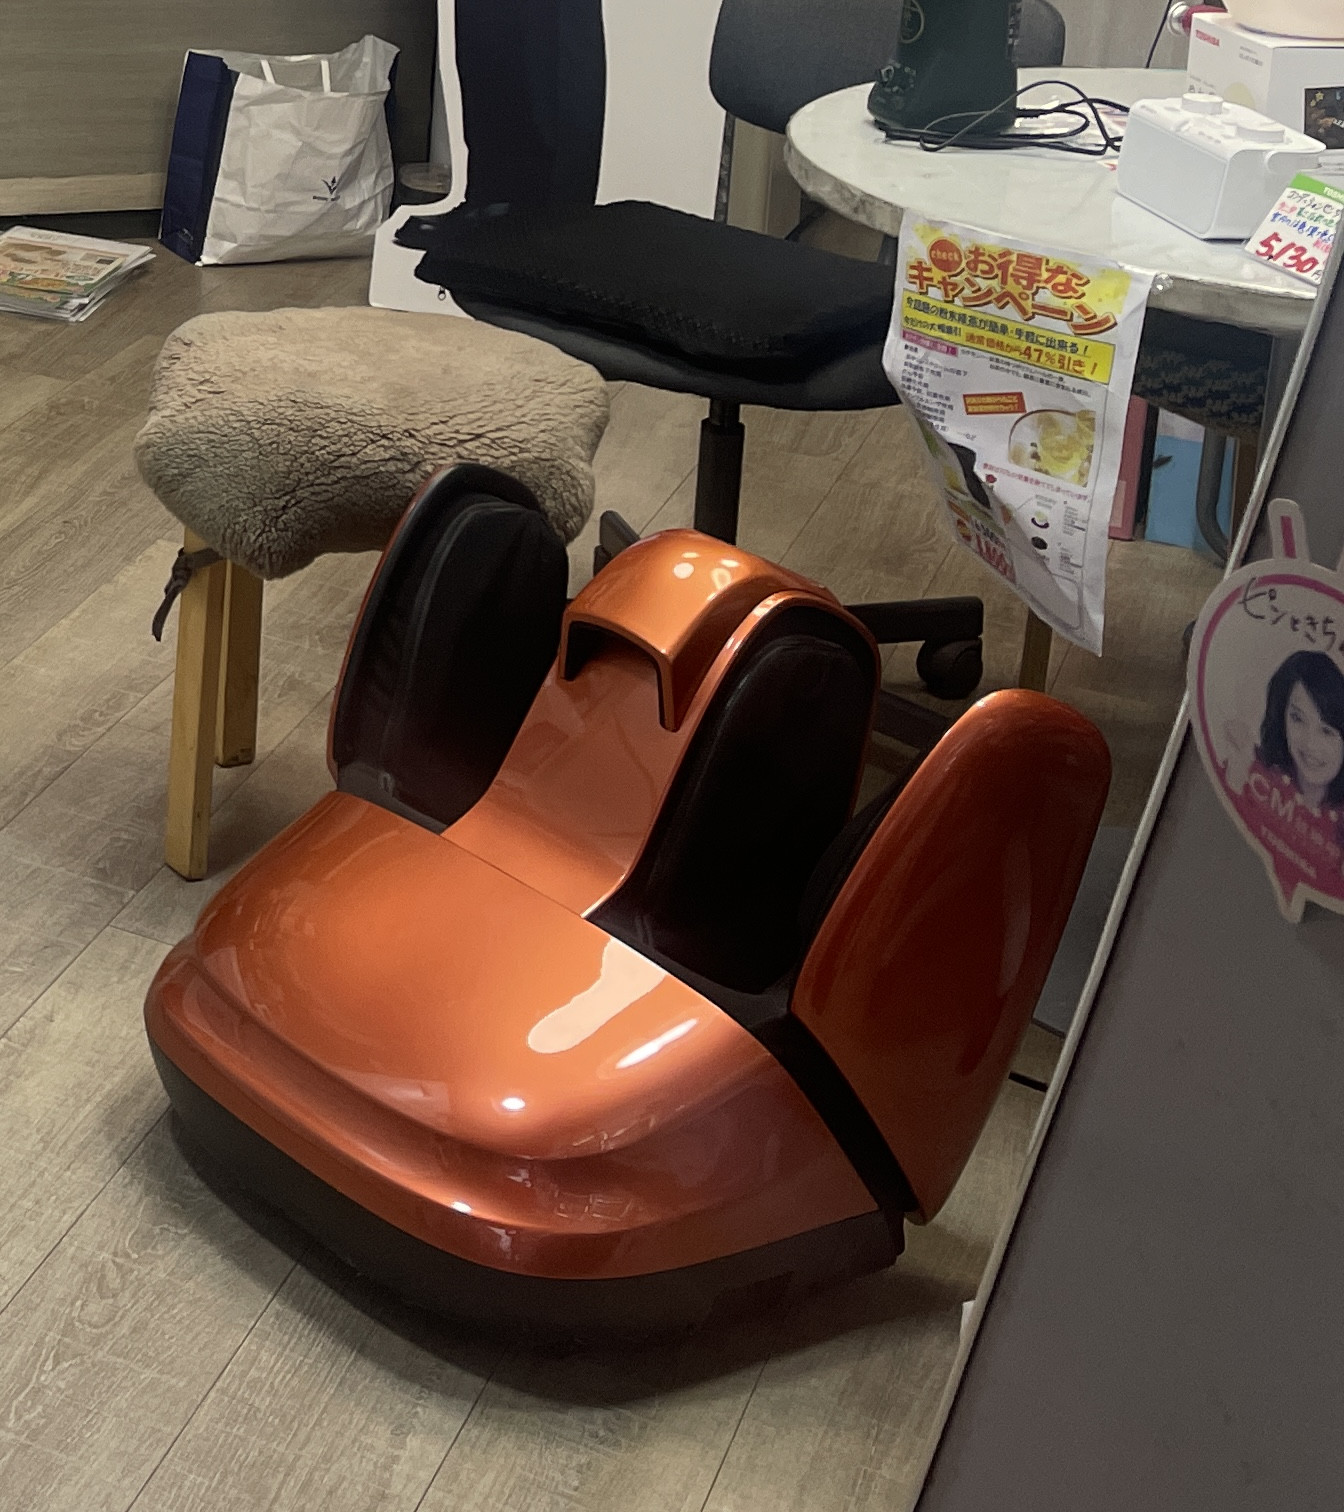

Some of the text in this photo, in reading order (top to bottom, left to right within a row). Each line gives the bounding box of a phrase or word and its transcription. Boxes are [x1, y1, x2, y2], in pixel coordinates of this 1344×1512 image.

[1195, 29, 1220, 47] TOSHIBA
[929, 247, 962, 264] check
[965, 244, 1091, 300] お得な
[906, 260, 1117, 337] キャンペーン
